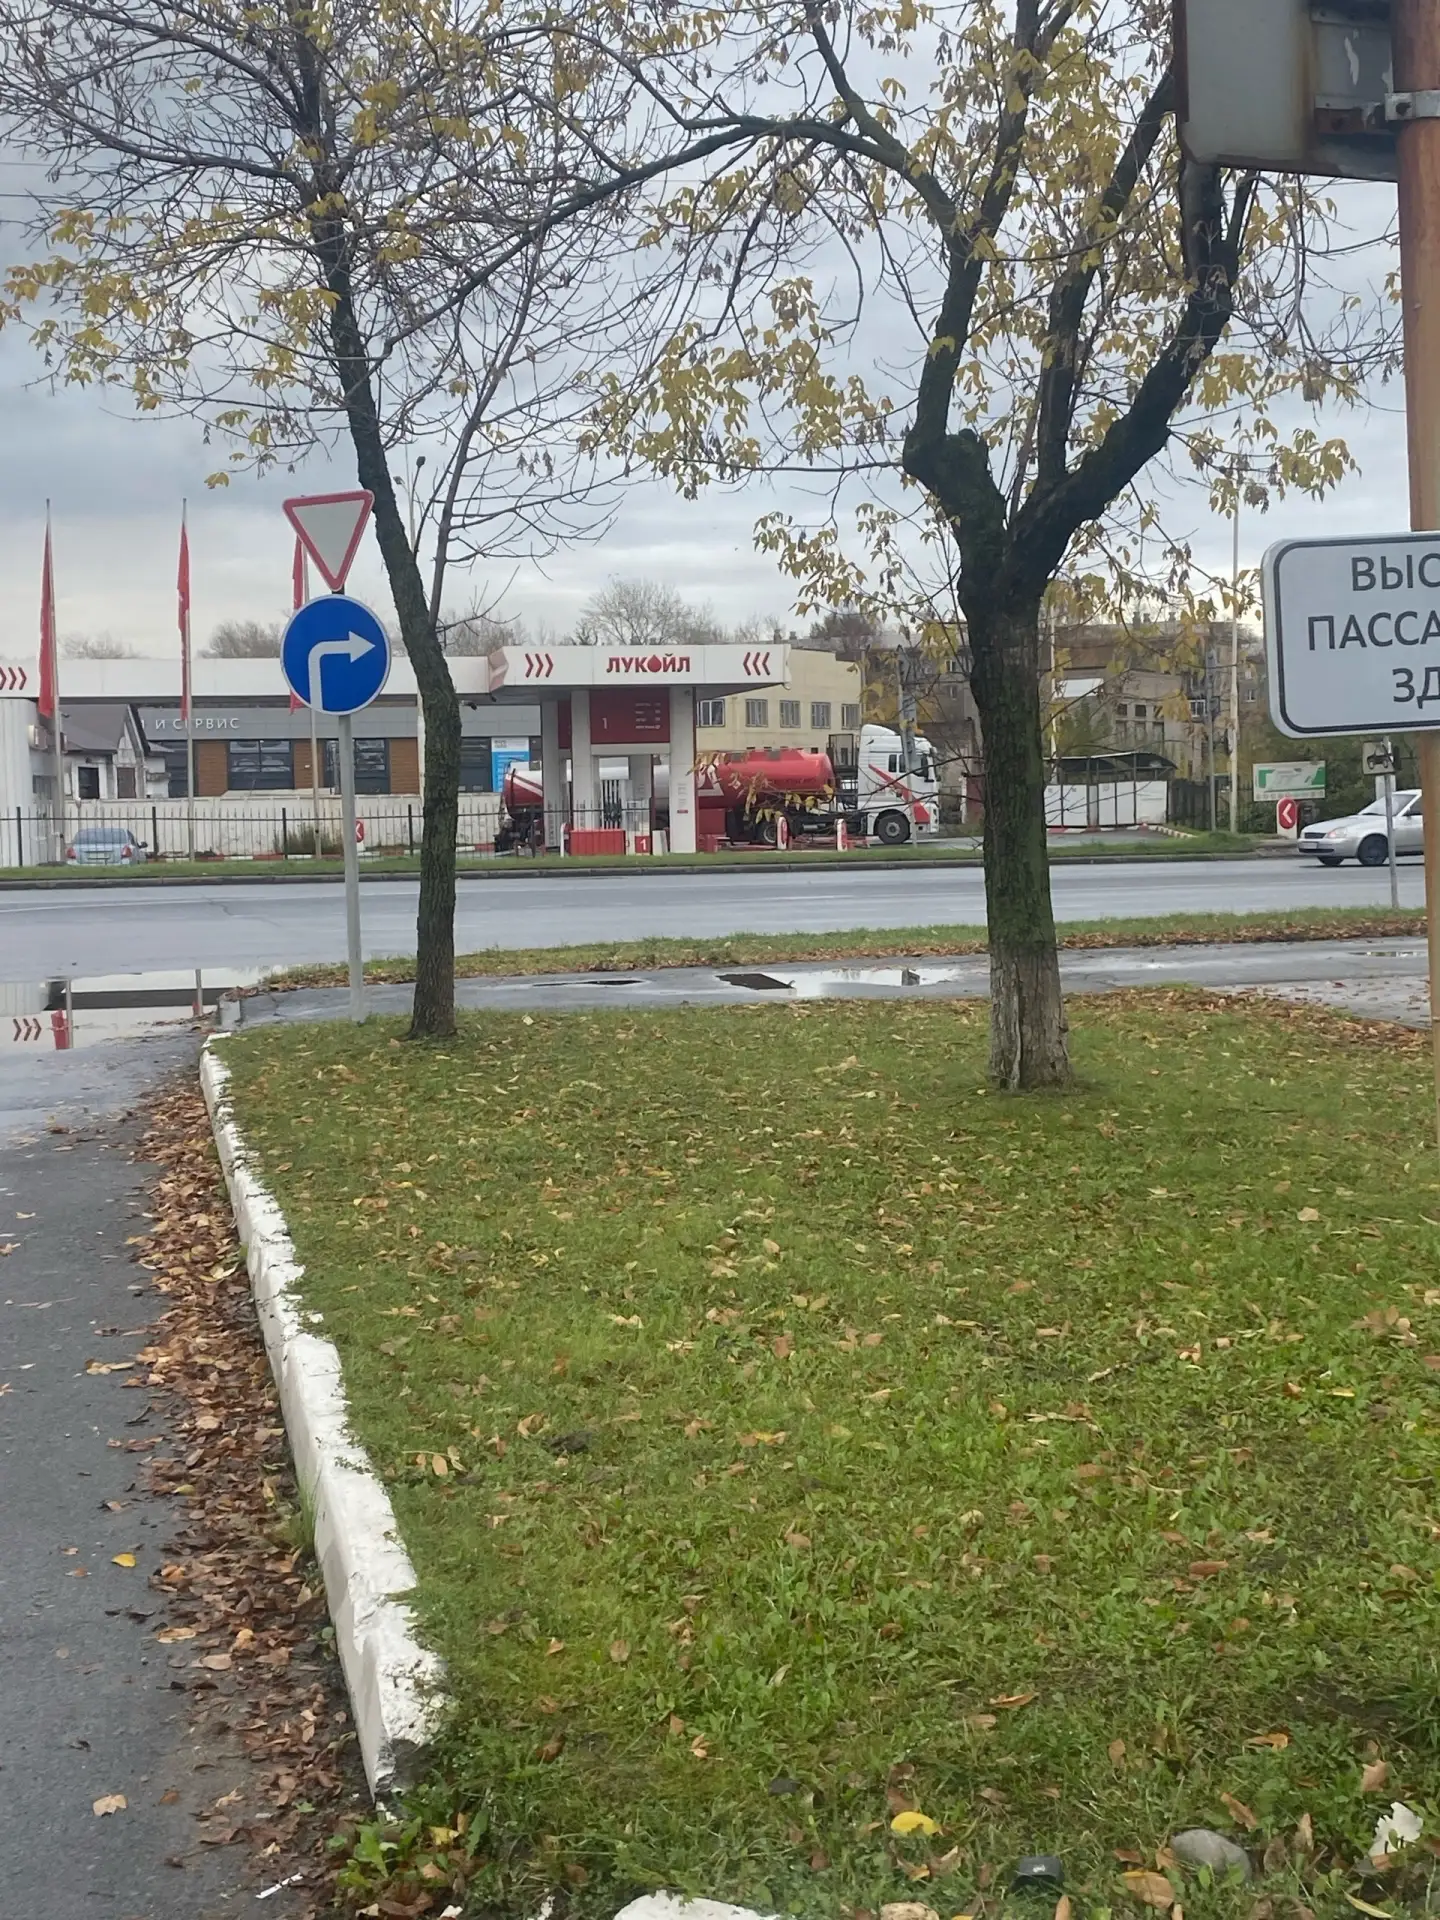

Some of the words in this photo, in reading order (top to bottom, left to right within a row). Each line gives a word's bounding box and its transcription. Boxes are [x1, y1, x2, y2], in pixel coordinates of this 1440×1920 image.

[606, 653, 690, 673] ЛУКОЙЛ
[172, 718, 240, 730] СРВИС
[602, 717, 608, 730] 1
[640, 838, 647, 851] 1
